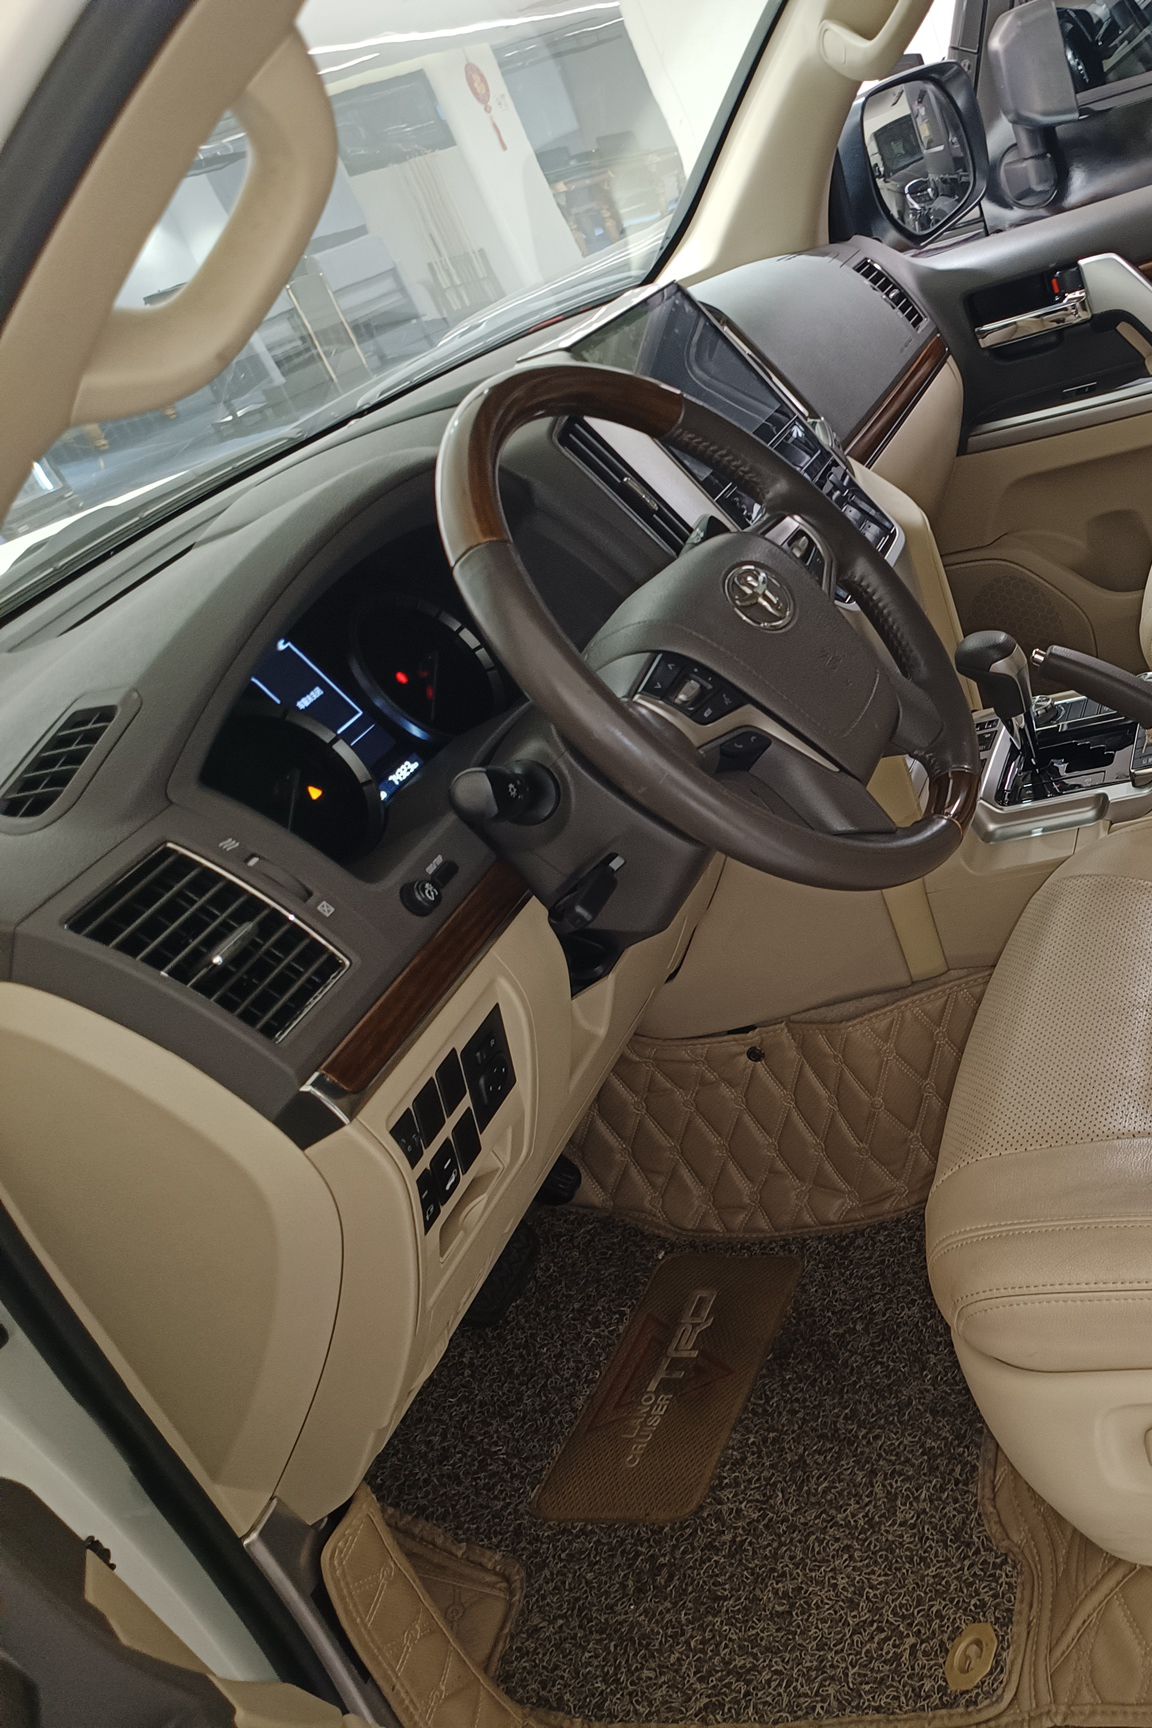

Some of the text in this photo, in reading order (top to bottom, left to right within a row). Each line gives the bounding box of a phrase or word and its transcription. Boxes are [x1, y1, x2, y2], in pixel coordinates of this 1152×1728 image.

[646, 1289, 718, 1392] TRD
[622, 1391, 657, 1439] LAND
[625, 1394, 673, 1468] CRUISER
